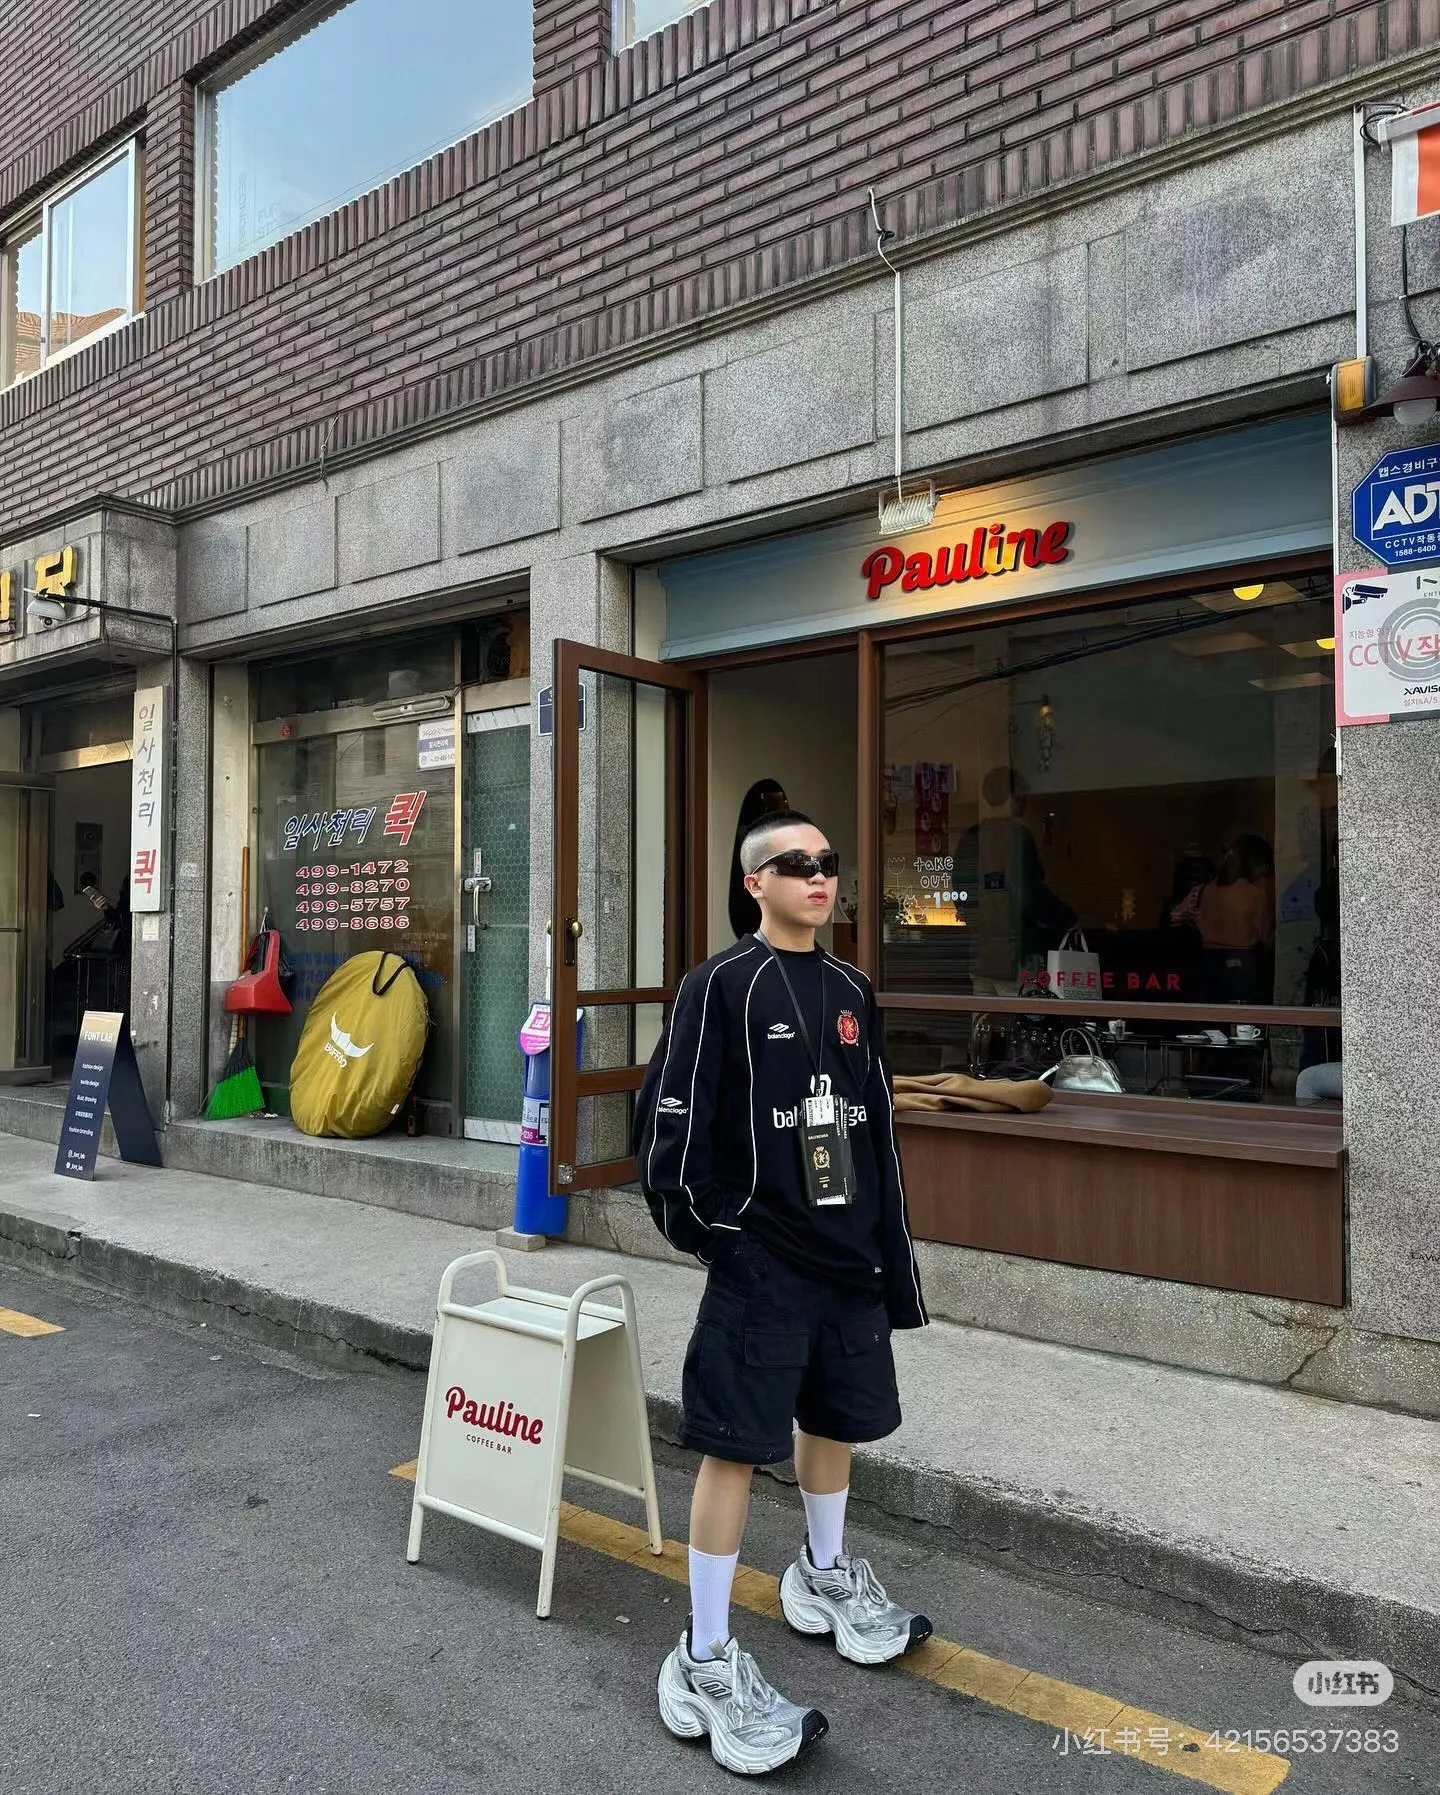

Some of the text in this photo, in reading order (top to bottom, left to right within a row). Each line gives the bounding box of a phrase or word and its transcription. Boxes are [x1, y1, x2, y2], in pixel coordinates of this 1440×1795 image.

[1379, 458, 1440, 478] 캡스경비구
[861, 521, 1070, 600] Pauline
[1395, 544, 1437, 557] 1588-6400
[1349, 638, 1413, 667] CCTV
[1403, 684, 1440, 696] XAVIS
[134, 703, 157, 894] 일사천리 퀵
[283, 790, 427, 851] 일사천리 퀵
[296, 859, 409, 879] 499-1472
[296, 878, 410, 896] 499-8270
[296, 896, 410, 914] 499-5757
[296, 915, 410, 931] 499-8686
[1018, 971, 1182, 991] COFFEE BAR
[84, 1031, 100, 1041] FONT
[445, 1386, 544, 1445] Pauline
[466, 1433, 513, 1455] COFFEE BAR
